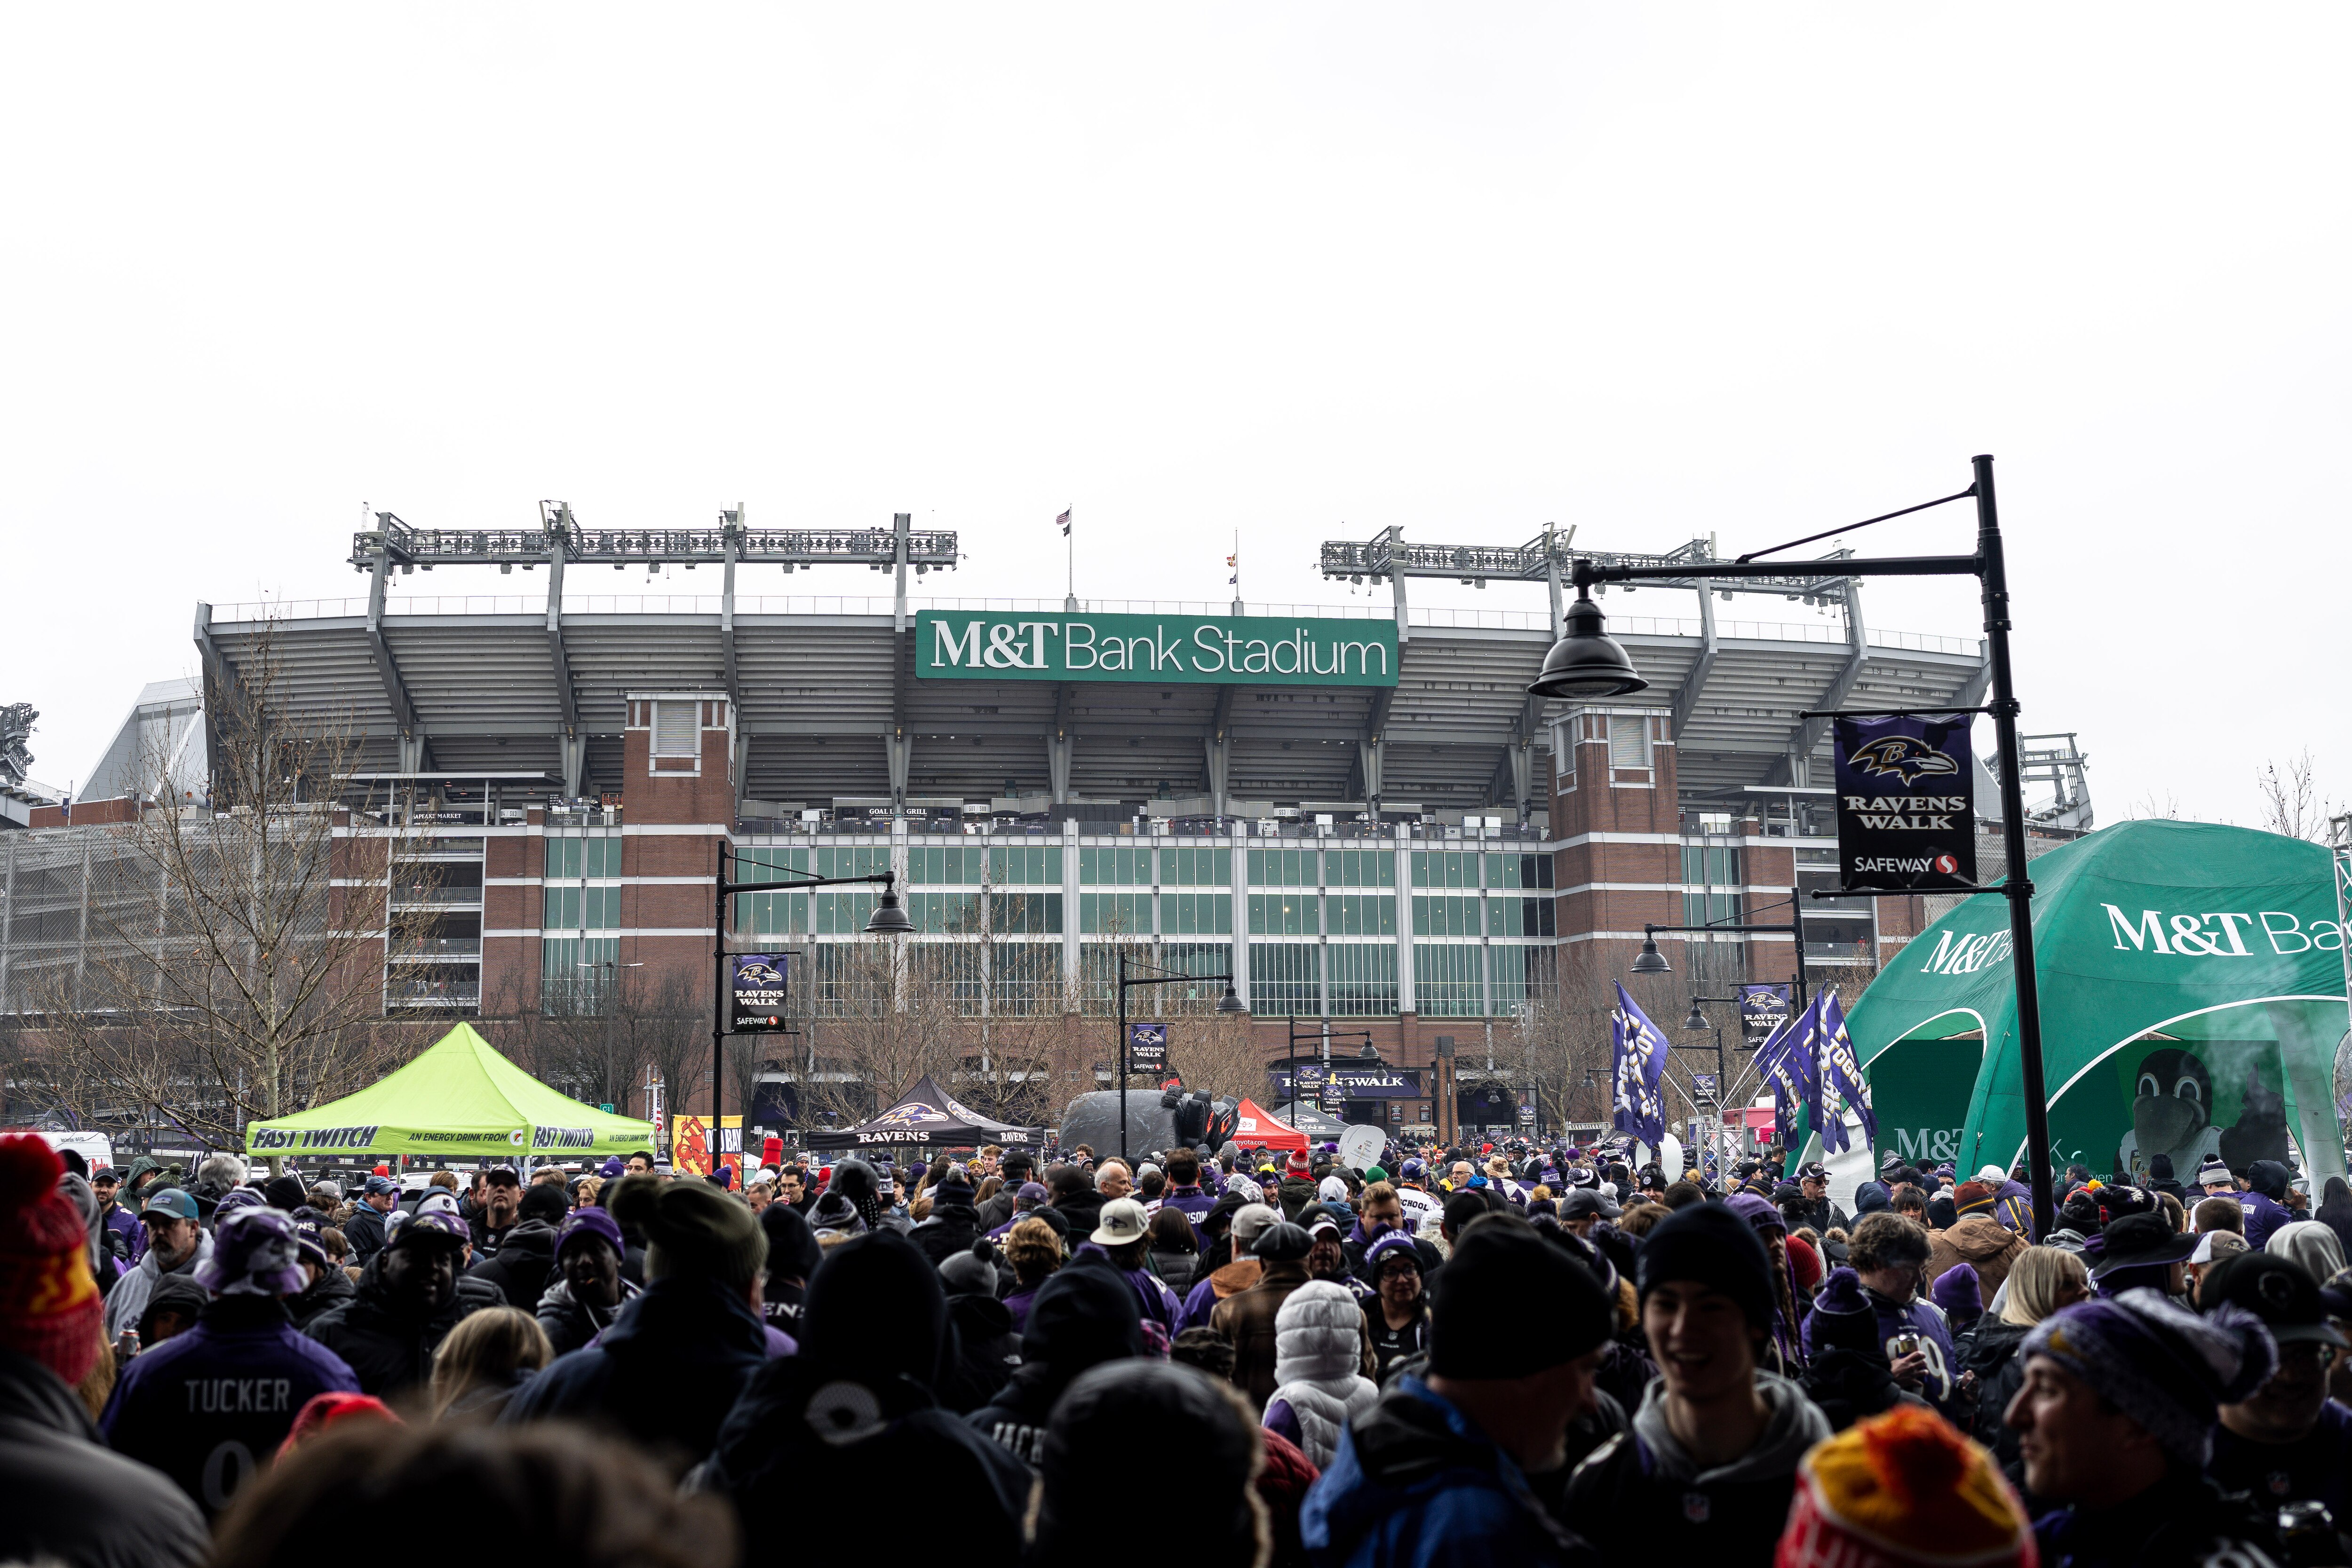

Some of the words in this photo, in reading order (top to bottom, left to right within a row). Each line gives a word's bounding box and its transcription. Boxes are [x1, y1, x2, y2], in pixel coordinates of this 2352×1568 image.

[930, 620, 1058, 669] M&T
[1065, 623, 1183, 672] Bank
[1192, 624, 1387, 676] Stadium
[1842, 796, 1966, 814] RAVENS
[1855, 814, 1955, 830] WALK
[1854, 857, 1933, 873] SAFEWAY
[2100, 902, 2254, 956] M&T
[1920, 929, 2011, 975] M&T
[734, 990, 784, 998] RAVENS
[1281, 1077, 1404, 1087] RENSWALK
[252, 1128, 301, 1149] FAST
[300, 1126, 379, 1149] TWITCH
[423, 1133, 456, 1141] ENERGY
[456, 1133, 483, 1141] DRINK
[483, 1133, 509, 1142] FROM
[532, 1125, 559, 1148] FAST
[557, 1127, 595, 1148] TWITCH
[724, 1128, 742, 1152] BAY
[856, 1131, 930, 1143] RAVENS
[1000, 1132, 1028, 1143] RAVENS
[183, 1377, 292, 1414] TUCKER
